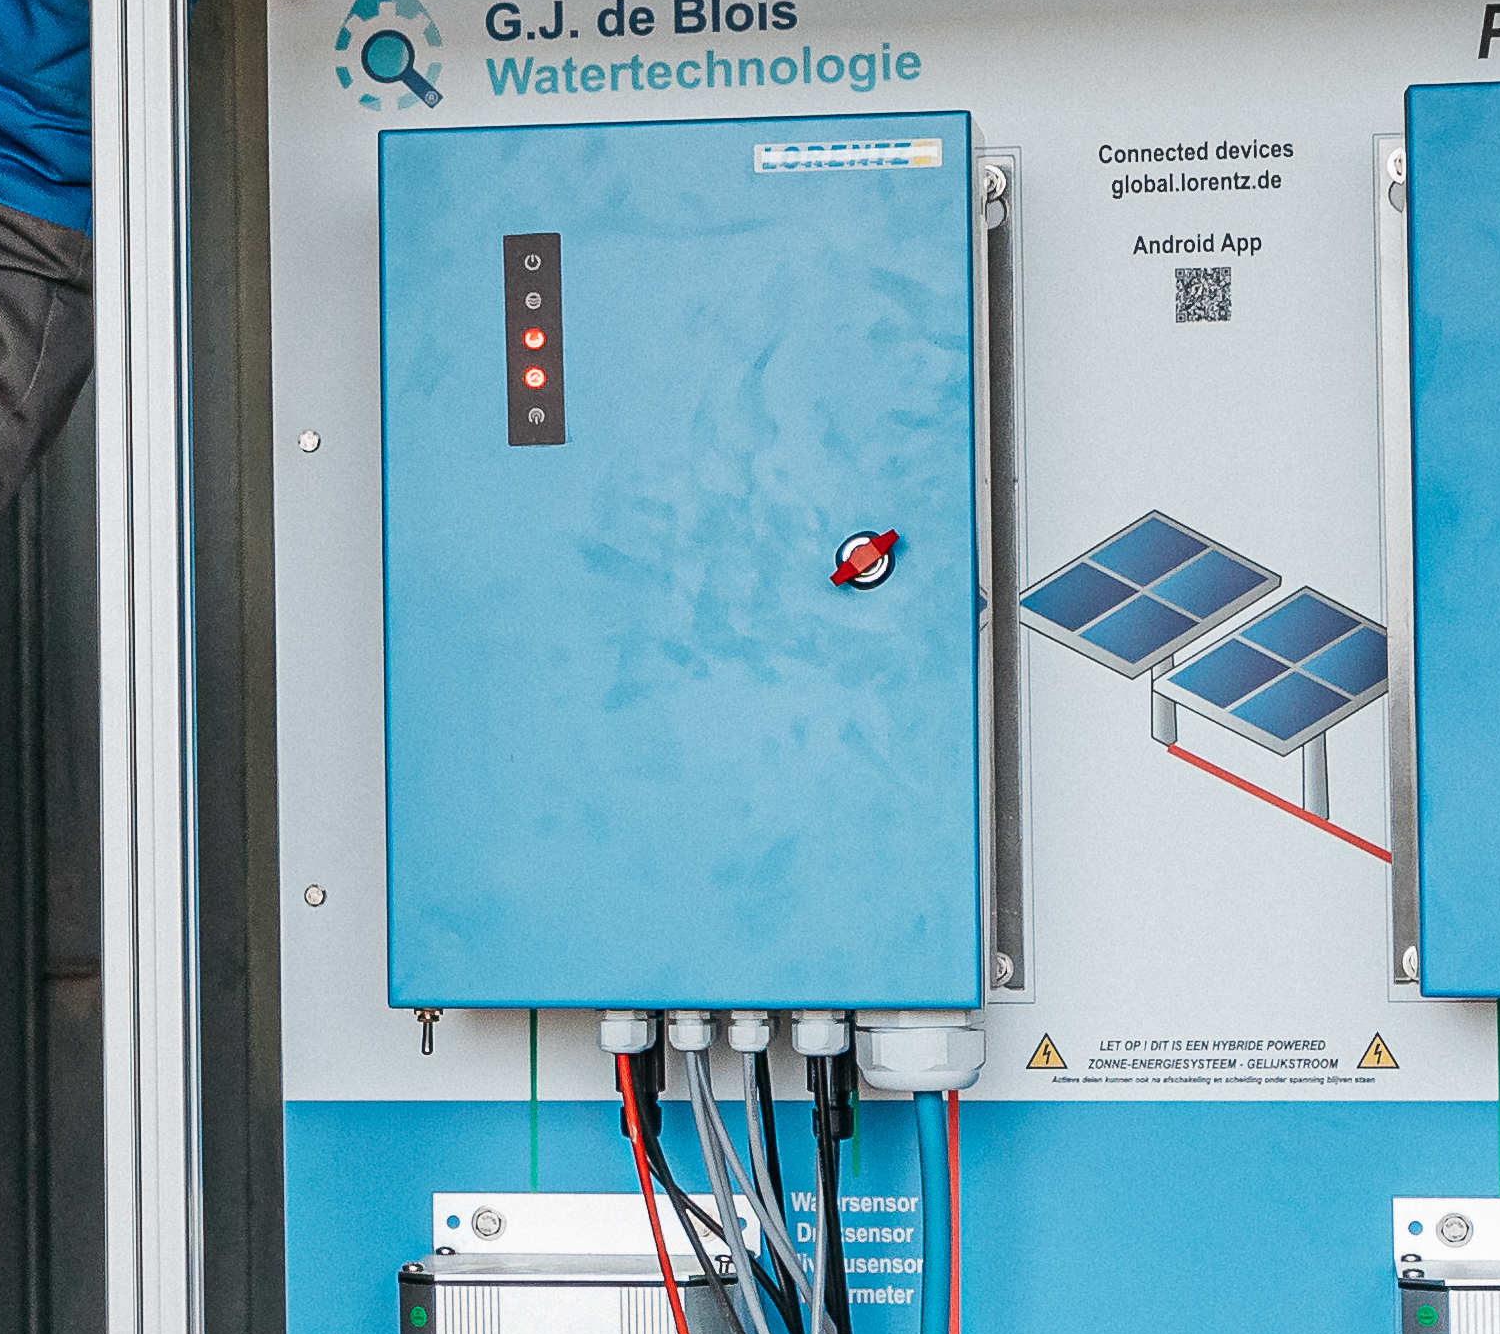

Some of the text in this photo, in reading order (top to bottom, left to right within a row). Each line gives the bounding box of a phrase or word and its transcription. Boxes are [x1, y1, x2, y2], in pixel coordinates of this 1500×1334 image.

[485, 0, 579, 41] G.J.
[486, 41, 923, 95] Watertechnologie
[1098, 140, 1294, 165] Connected devices
[1111, 170, 1282, 199] global.lorentz.de
[1133, 233, 1262, 259] Android App
[1099, 1040, 1121, 1052] LET
[1125, 1040, 1142, 1052] OP
[1150, 1040, 1169, 1052] DIT
[1171, 1040, 1182, 1052] IS
[1186, 1040, 1209, 1052] EEN
[1212, 1039, 1263, 1052] HYBRIDE
[1267, 1039, 1326, 1052] POWERED
[1088, 1058, 1237, 1070] ZONNE-ENERGIESYSTEEM
[1247, 1058, 1339, 1070] GELIJKSTROOM
